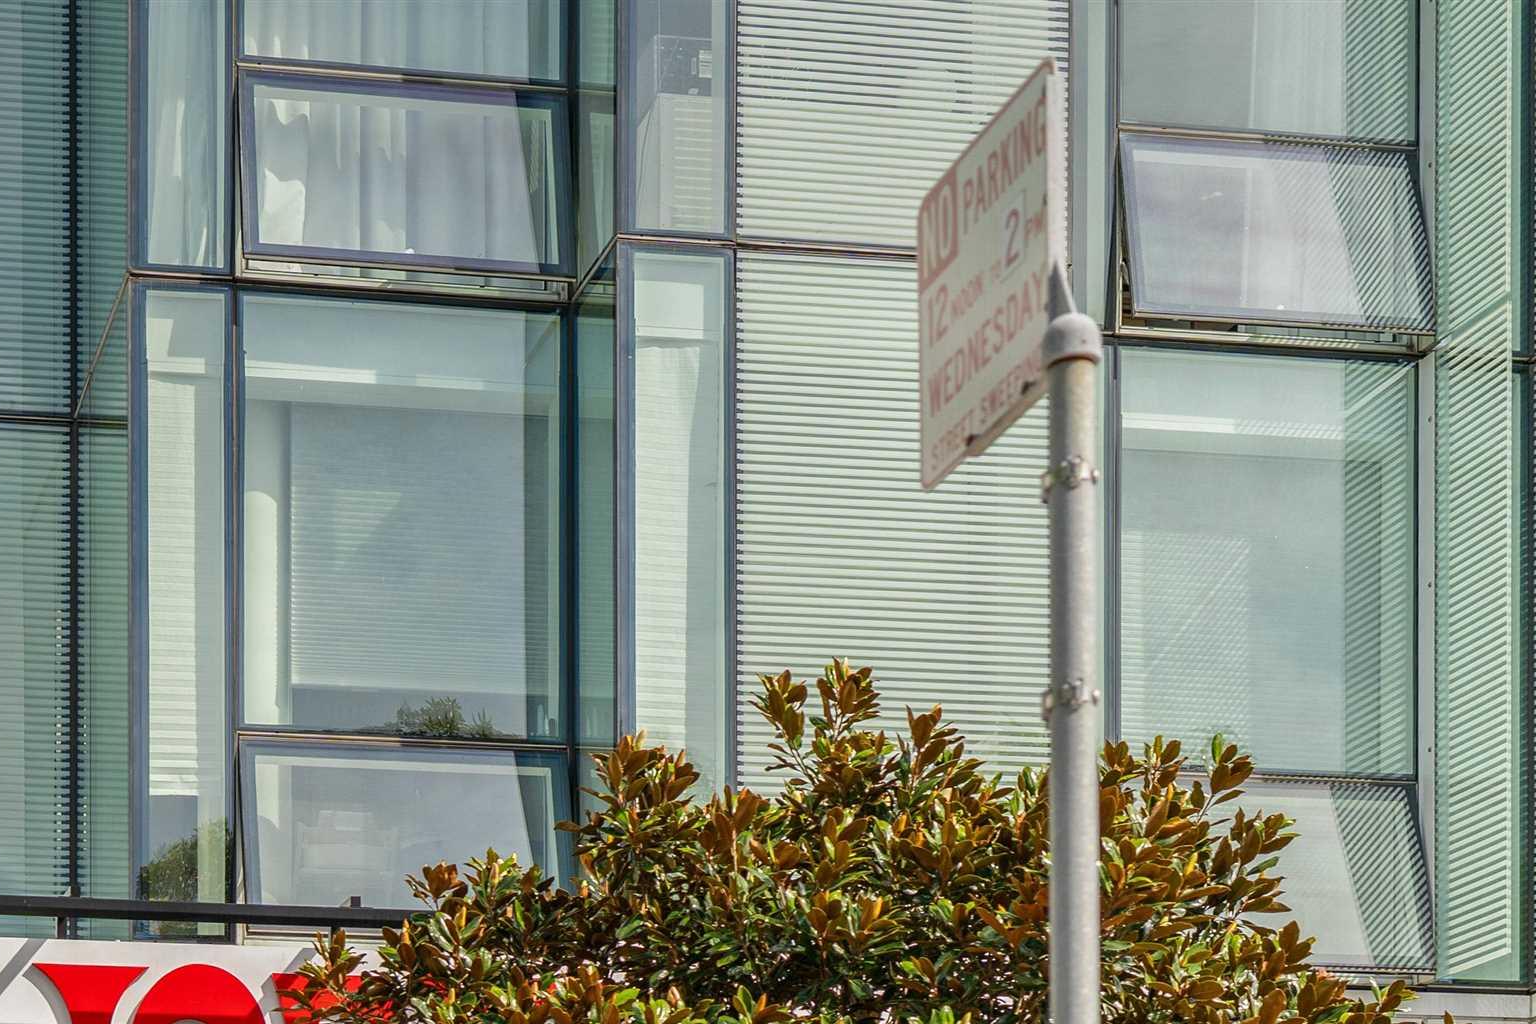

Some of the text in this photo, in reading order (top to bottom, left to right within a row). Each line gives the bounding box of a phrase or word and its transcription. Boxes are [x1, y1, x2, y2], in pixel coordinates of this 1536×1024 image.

[923, 96, 1047, 278] NO PARKING
[928, 284, 949, 349] 12
[1005, 208, 1020, 267] 2
[928, 271, 1044, 418] WEDNESDAY
[931, 408, 975, 471] STREET
